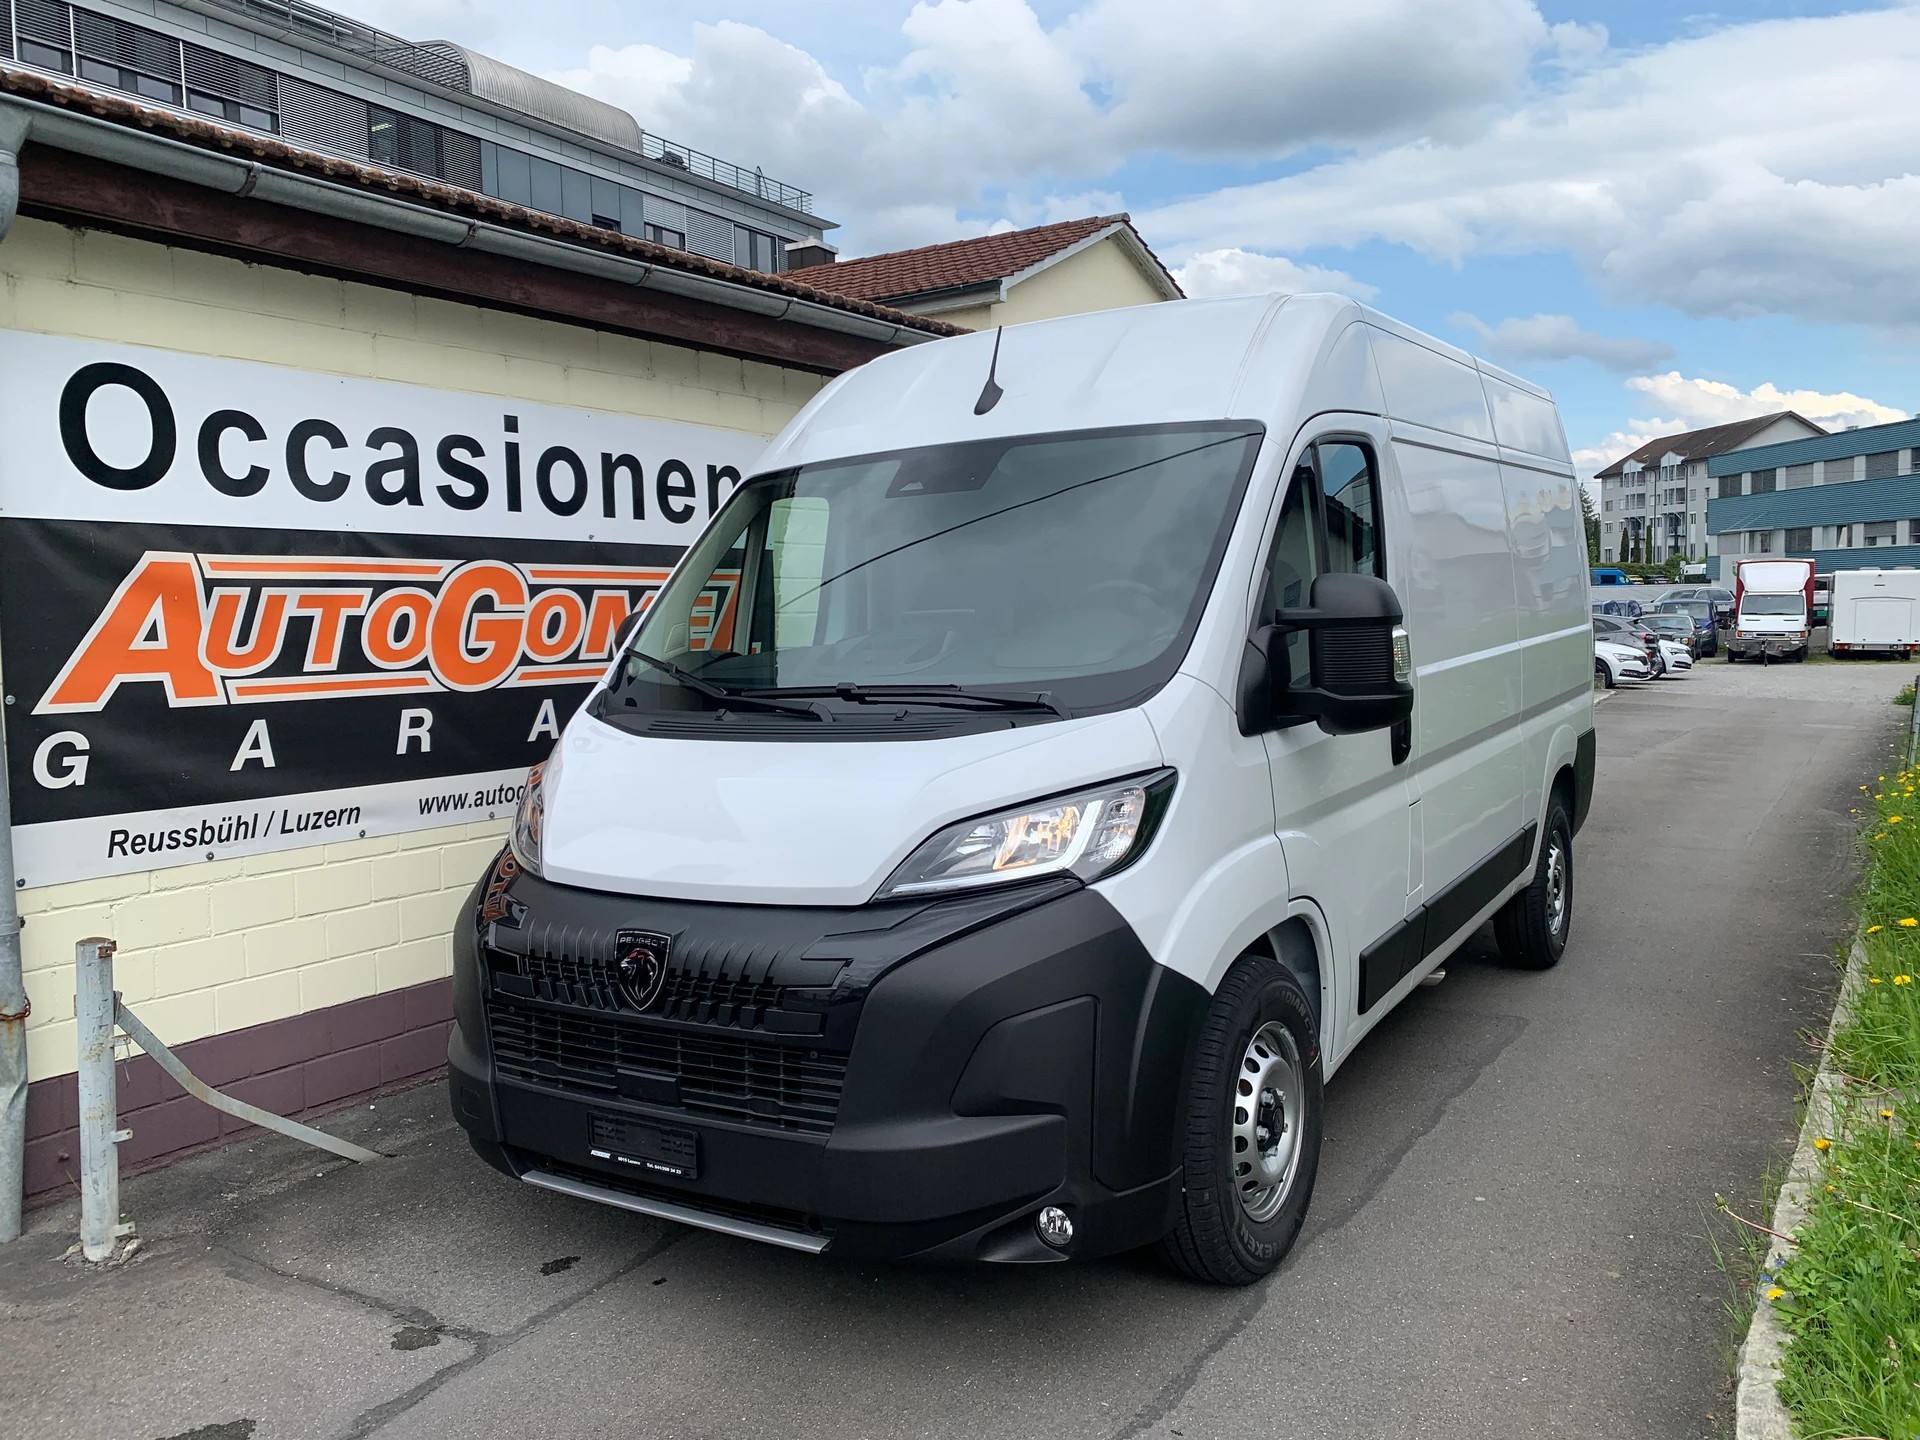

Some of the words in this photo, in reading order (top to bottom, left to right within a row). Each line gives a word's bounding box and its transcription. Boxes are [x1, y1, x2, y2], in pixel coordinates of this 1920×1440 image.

[59, 361, 742, 523] Occasionen
[107, 812, 259, 859] Reussbühl
[263, 810, 275, 838] /
[279, 805, 362, 835] Luzern
[619, 936, 666, 948] PEUGEOT
[1241, 1222, 1282, 1259] NEXEN
